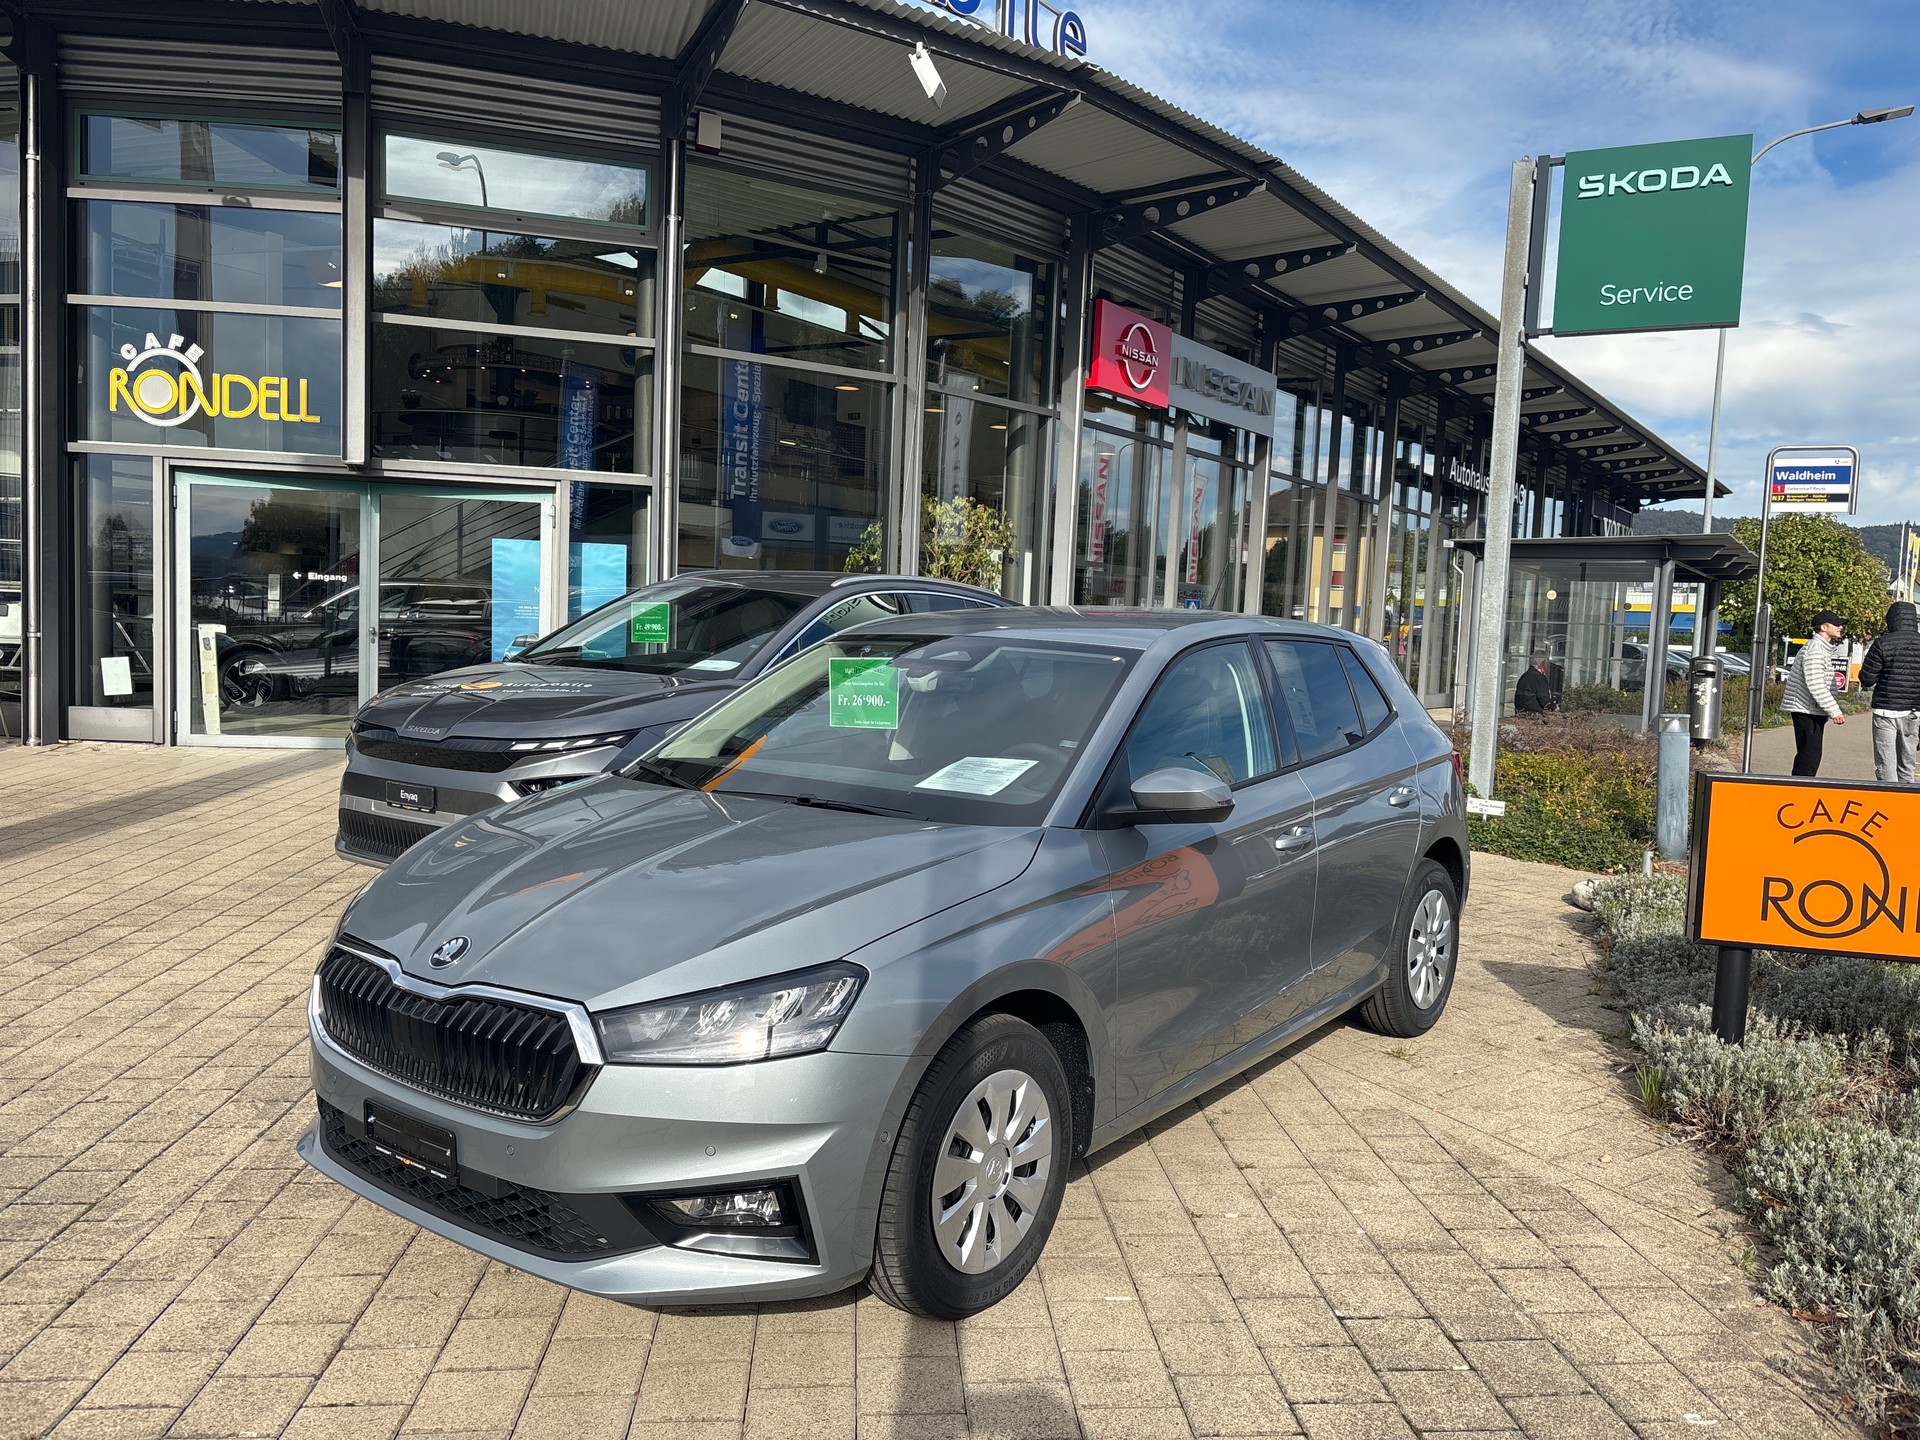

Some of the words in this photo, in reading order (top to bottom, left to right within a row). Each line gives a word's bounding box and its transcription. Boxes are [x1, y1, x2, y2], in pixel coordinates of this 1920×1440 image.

[1600, 281, 1694, 306] Service
[120, 332, 205, 364] CAFE
[1120, 343, 1160, 368] NISSAN
[109, 367, 321, 423] RONDELL
[1171, 355, 1274, 417] NISSAN
[730, 424, 748, 500] Transit
[1450, 456, 1490, 494] Autohaus
[1776, 471, 1836, 481] Waldheim
[308, 572, 347, 582] Eingang
[837, 694, 850, 706] Fr.
[406, 724, 441, 735] SKODA
[400, 789, 418, 803] Enyaq
[1776, 798, 1889, 839] CAFE
[1760, 876, 1920, 938] RON
